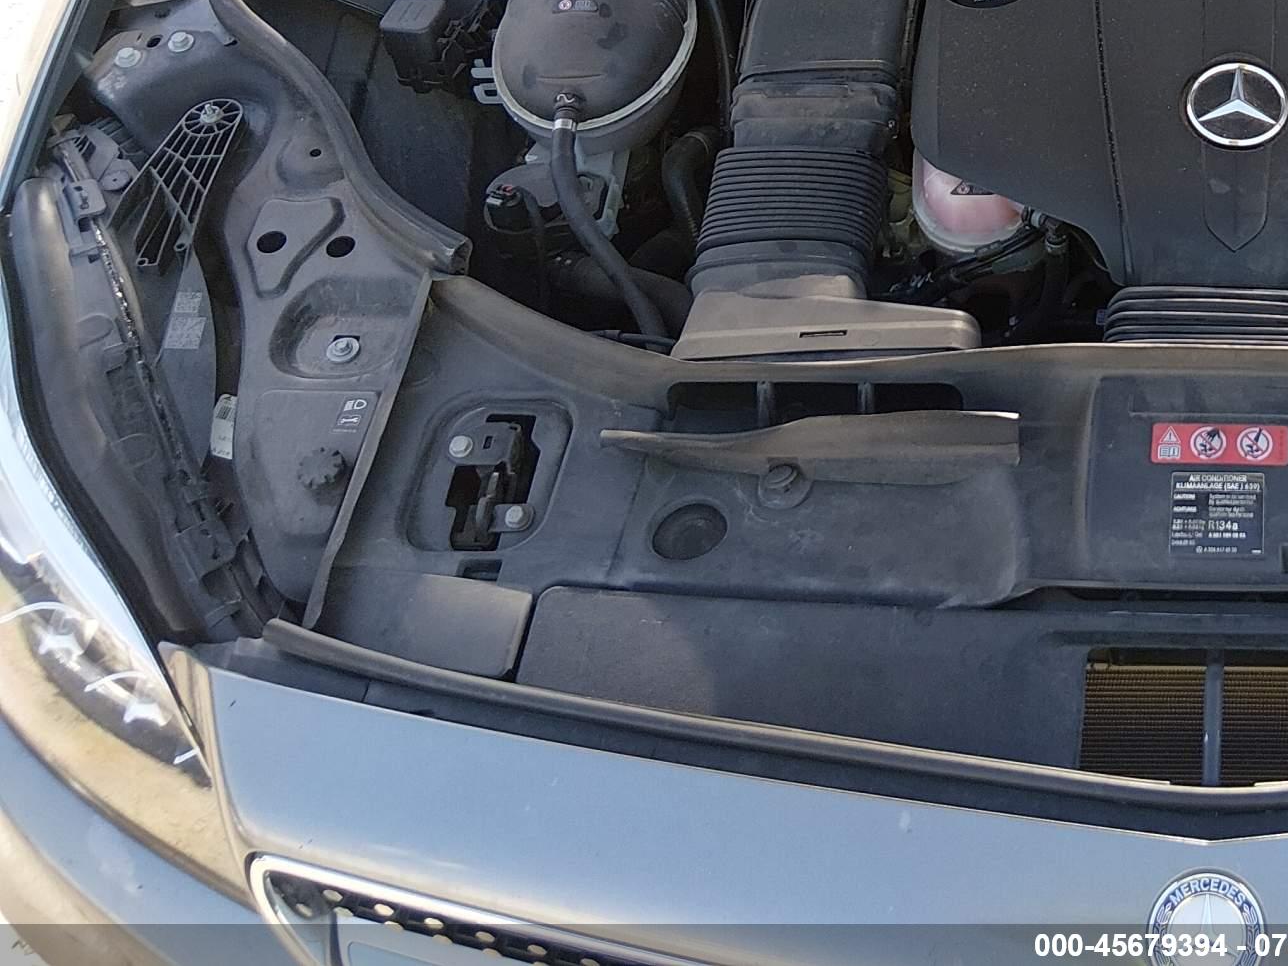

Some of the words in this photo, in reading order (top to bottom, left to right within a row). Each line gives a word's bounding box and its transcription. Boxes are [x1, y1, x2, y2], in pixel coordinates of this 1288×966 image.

[1189, 474, 1201, 482] AIR
[1201, 474, 1247, 482] CONDITIONER
[1208, 519, 1238, 531] R134a
[1169, 877, 1246, 906] MERCEDES
